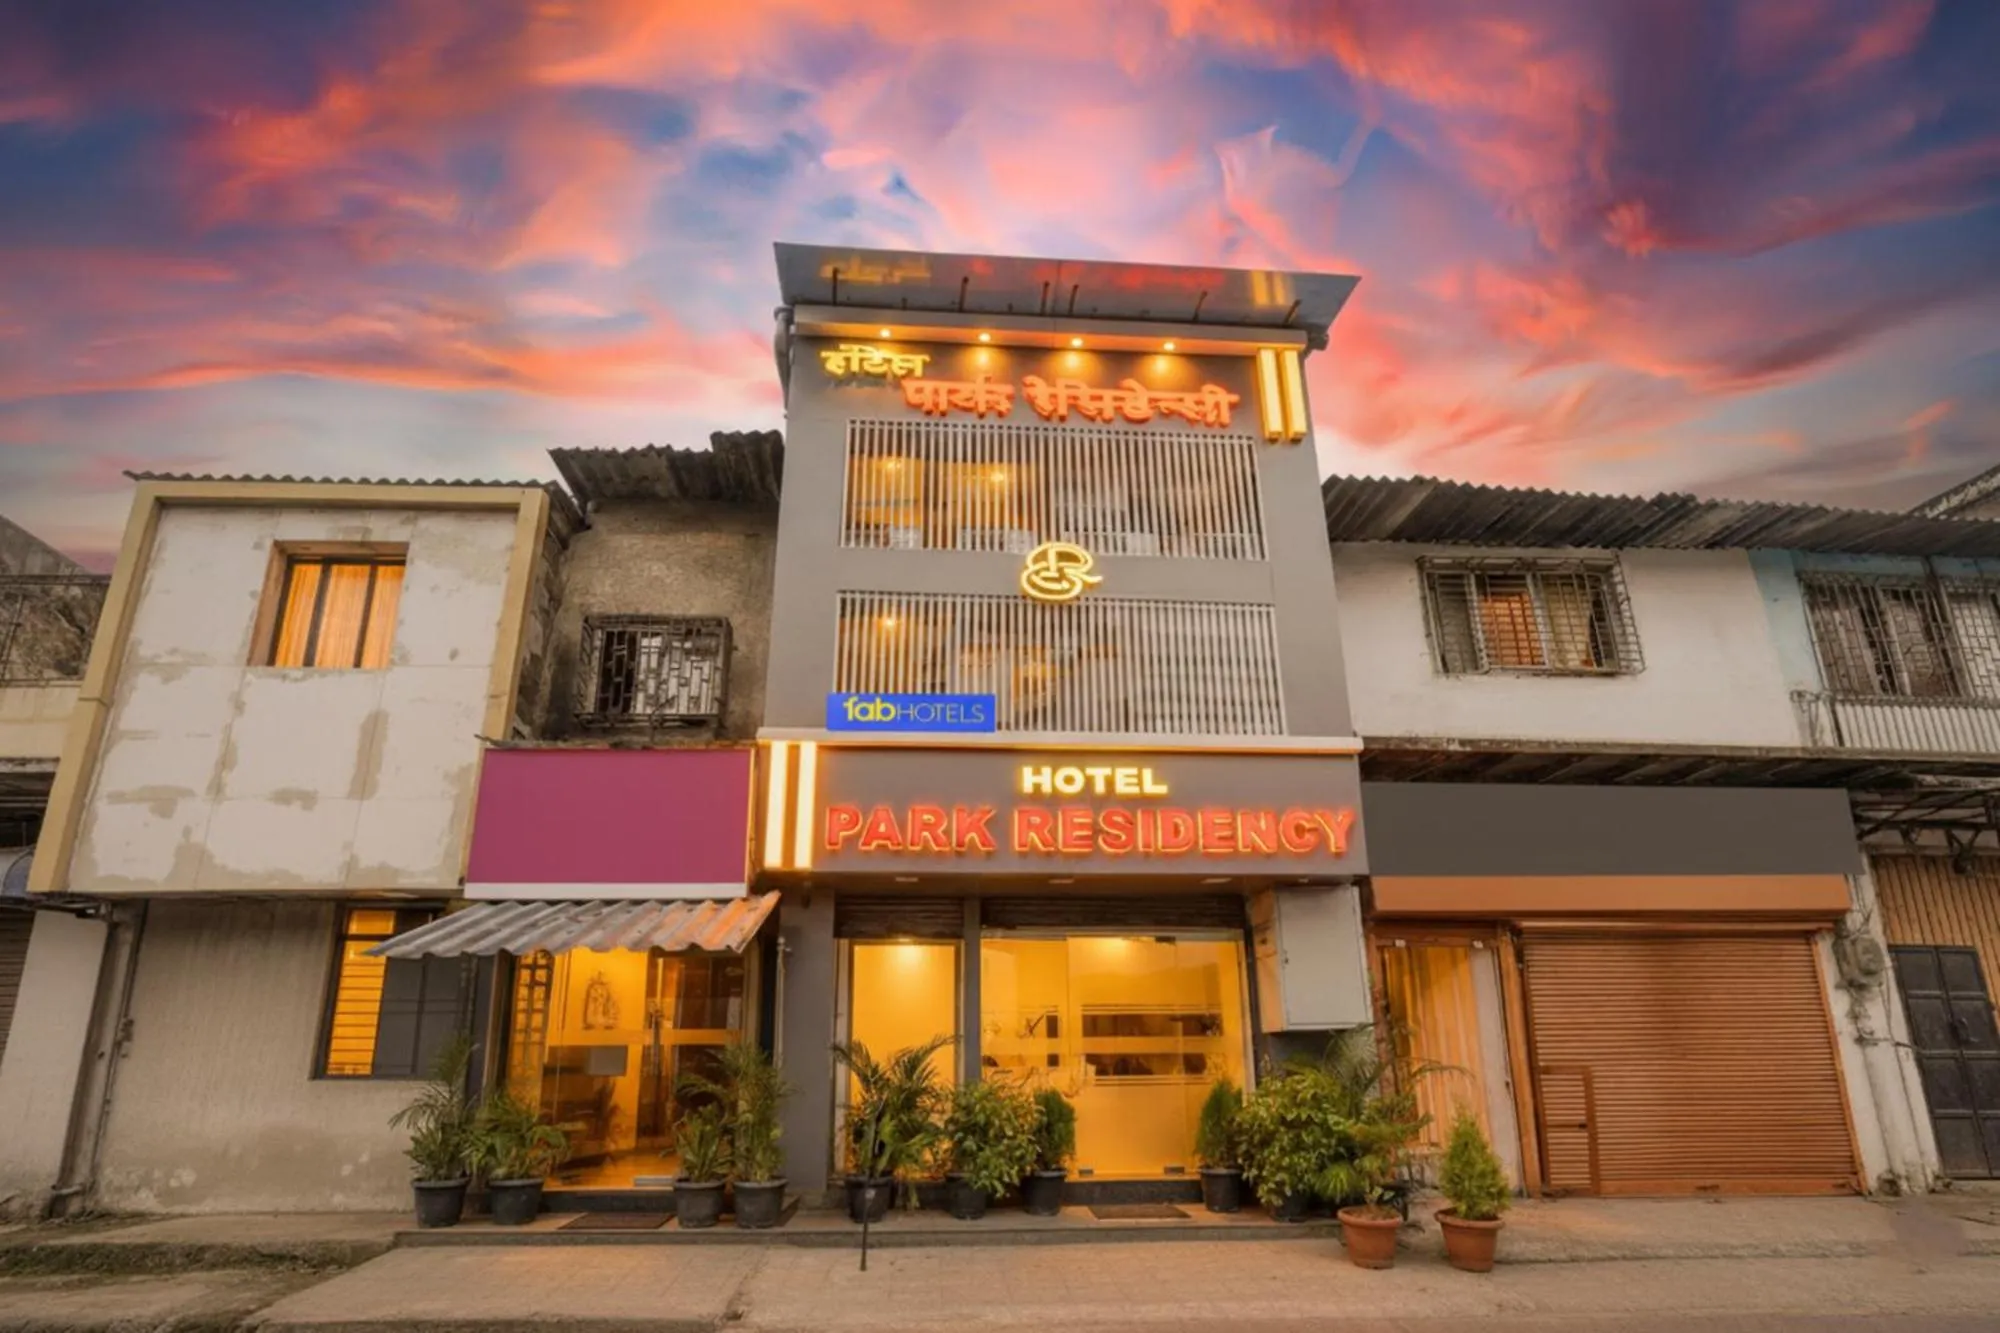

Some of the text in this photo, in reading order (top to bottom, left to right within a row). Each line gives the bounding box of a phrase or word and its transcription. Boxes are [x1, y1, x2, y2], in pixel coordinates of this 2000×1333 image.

[843, 696, 985, 723] fabHOTELS
[1022, 766, 1169, 794] HOTEL
[825, 806, 1355, 855] PARK RESIDENCY
